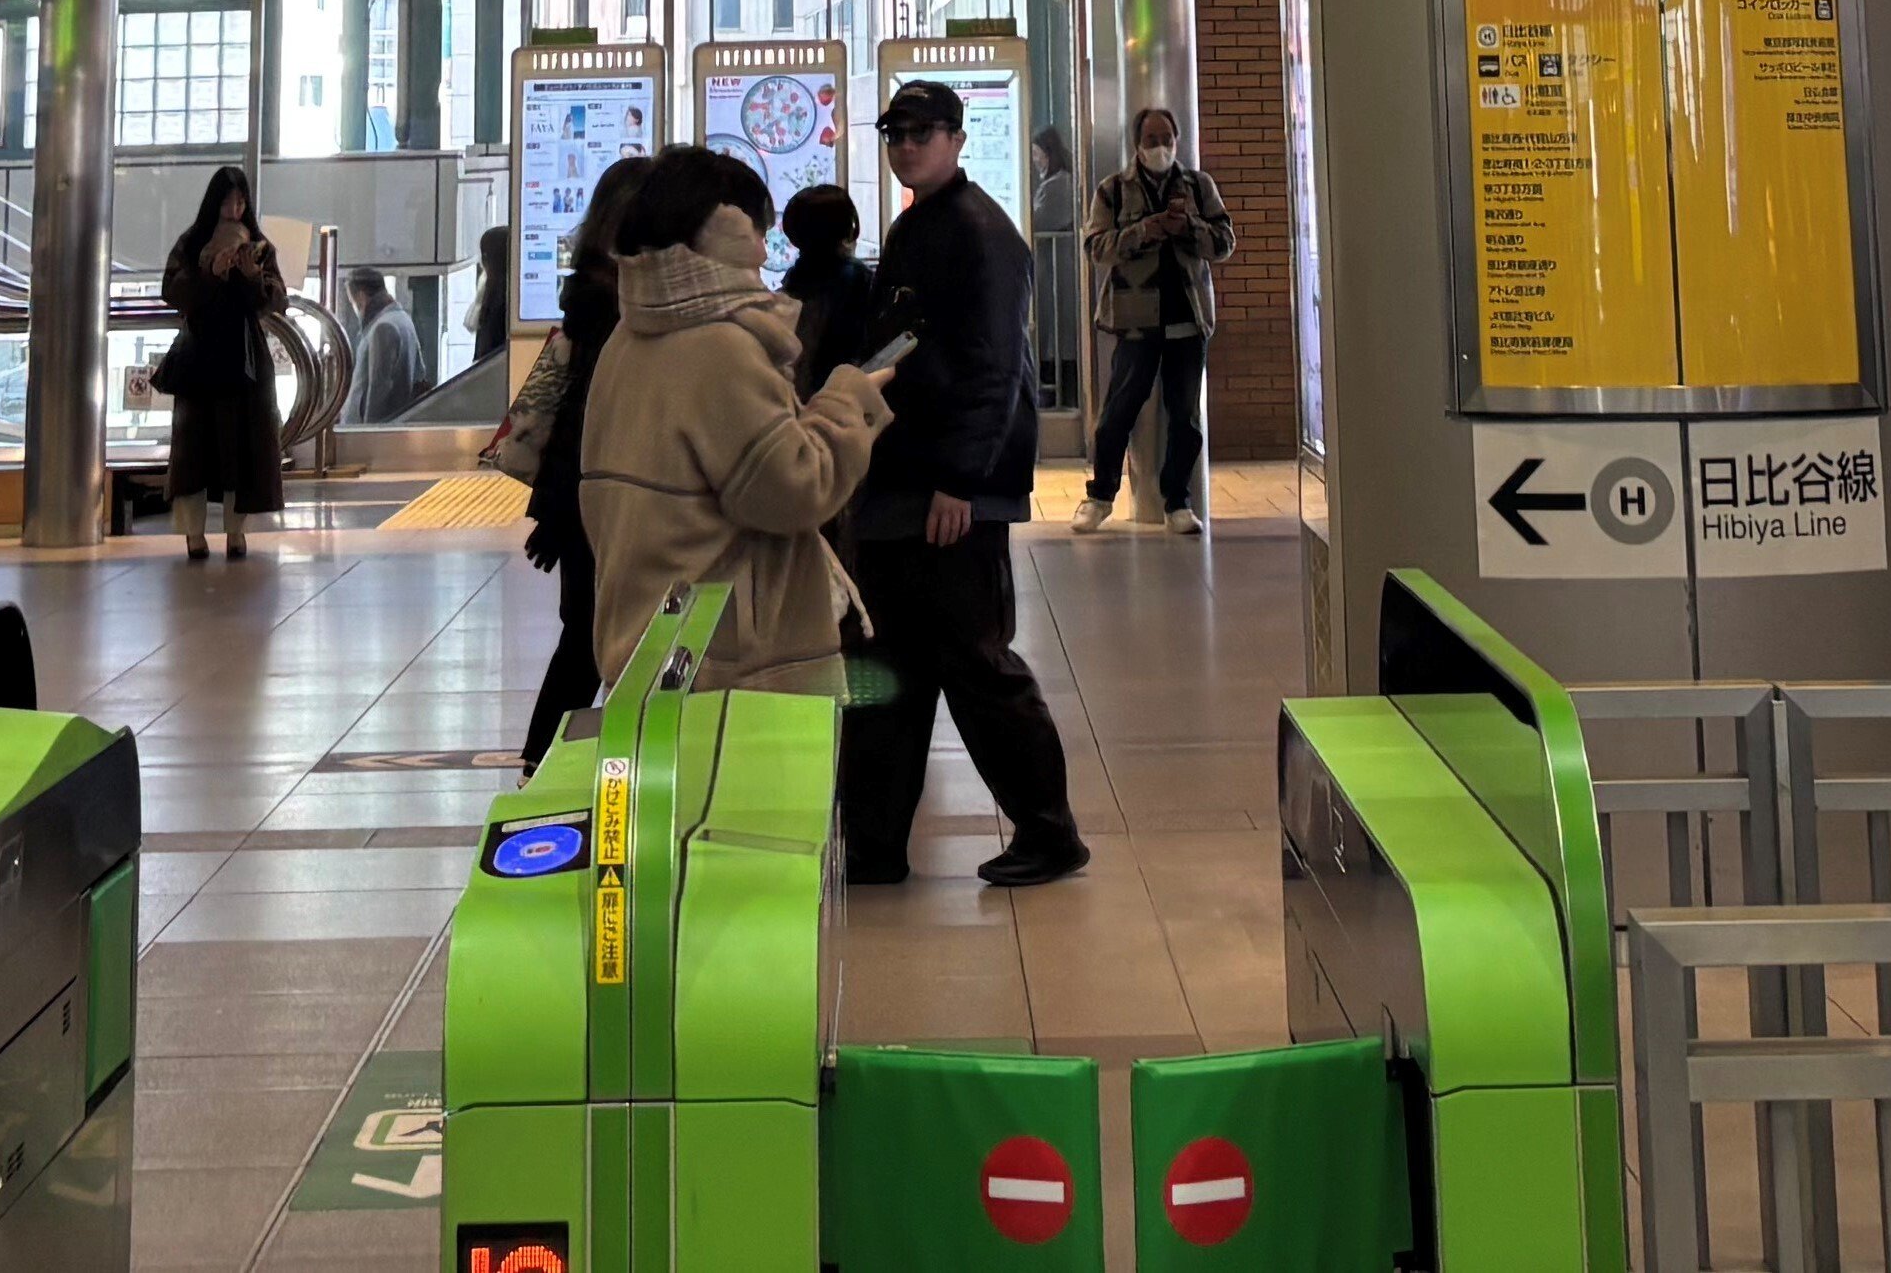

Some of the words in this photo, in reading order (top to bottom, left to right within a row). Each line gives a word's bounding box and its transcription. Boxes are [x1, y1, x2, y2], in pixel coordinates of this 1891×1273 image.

[1620, 486, 1646, 516] H
[1700, 449, 1878, 509] 日比谷線
[1702, 513, 1786, 544] Hibiya
[1793, 510, 1846, 537] Line
[604, 778, 622, 859] かけこみ禁止
